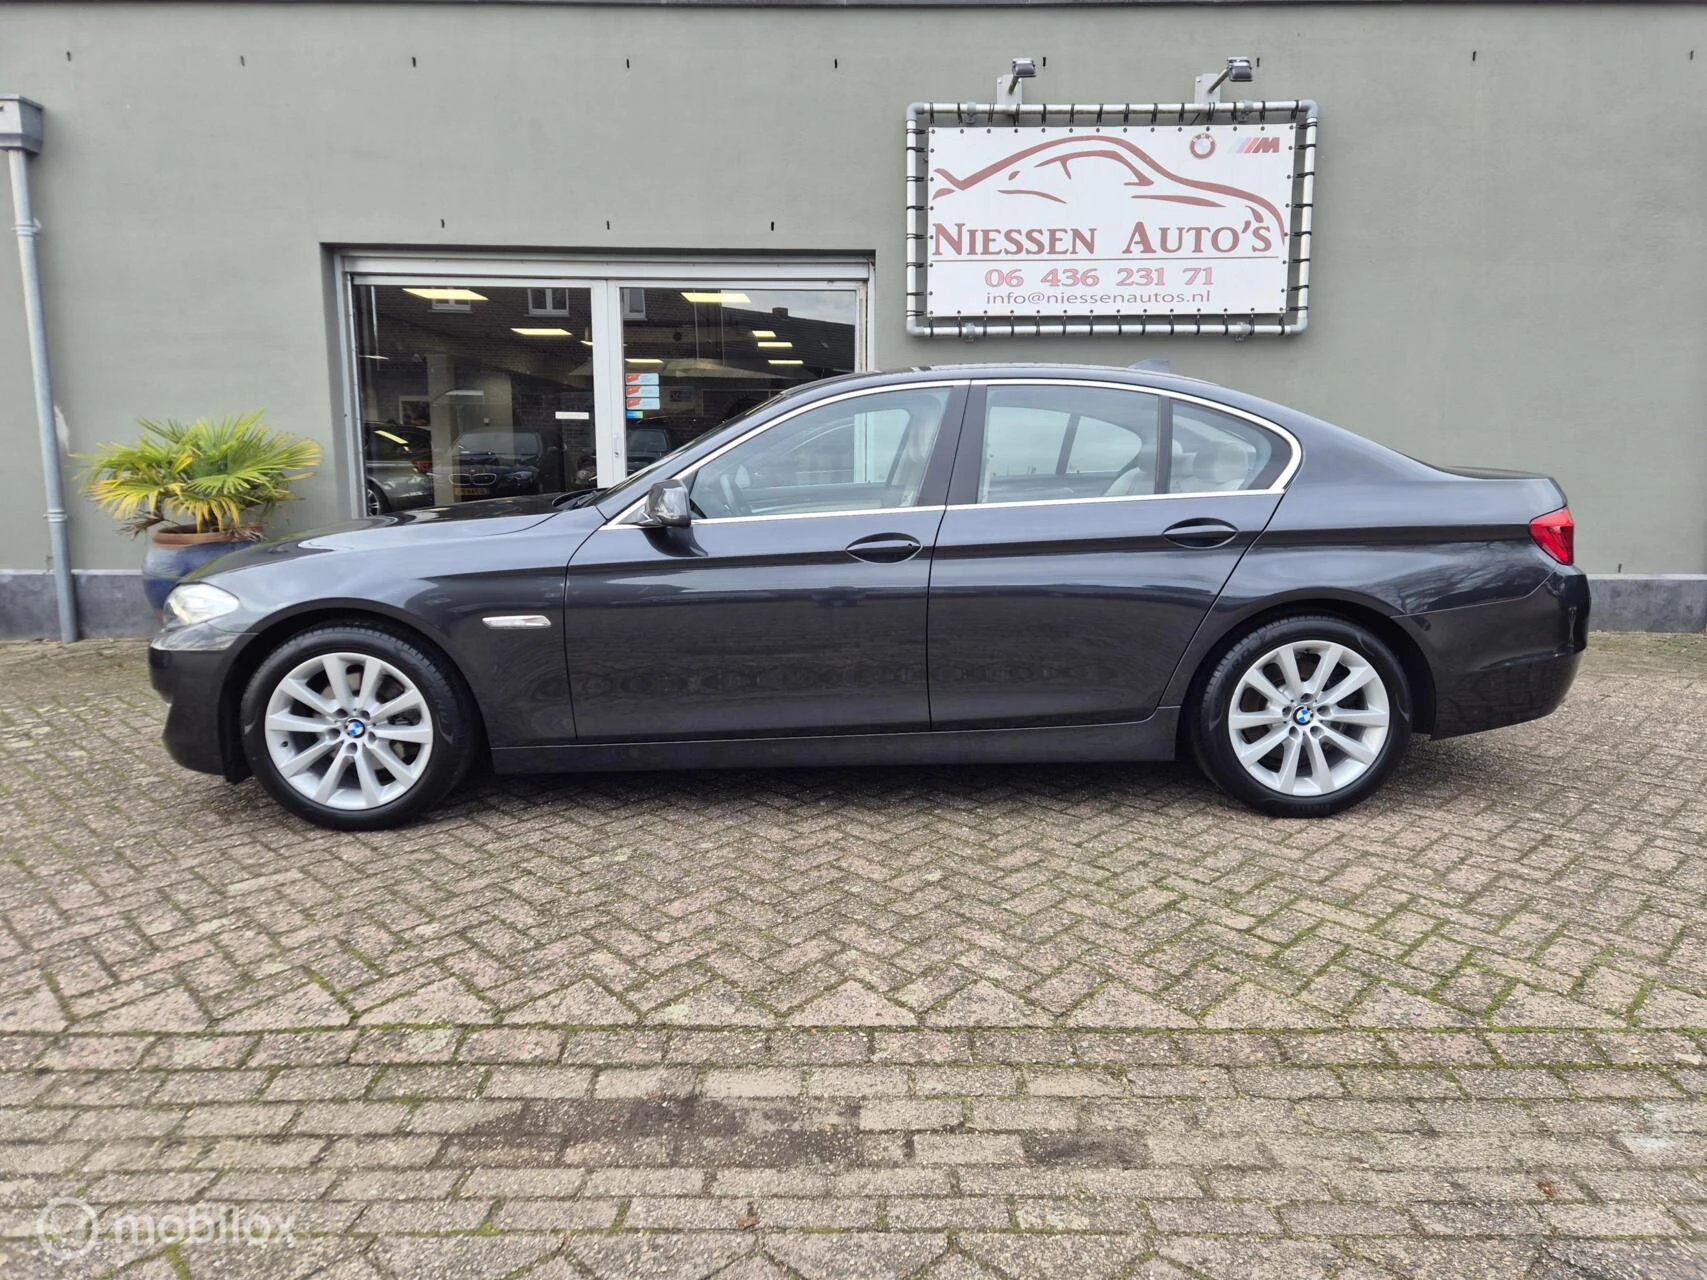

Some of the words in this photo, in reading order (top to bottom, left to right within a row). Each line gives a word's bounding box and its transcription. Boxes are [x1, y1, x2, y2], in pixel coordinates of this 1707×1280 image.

[932, 223, 1097, 256] NIESSEN
[1122, 221, 1273, 254] AUTO'S
[985, 268, 1025, 288] 06
[1040, 268, 1101, 288] 436
[1115, 267, 1167, 287] 231
[1182, 267, 1215, 287] 71
[986, 291, 1211, 305] info@niessenautos.nl
